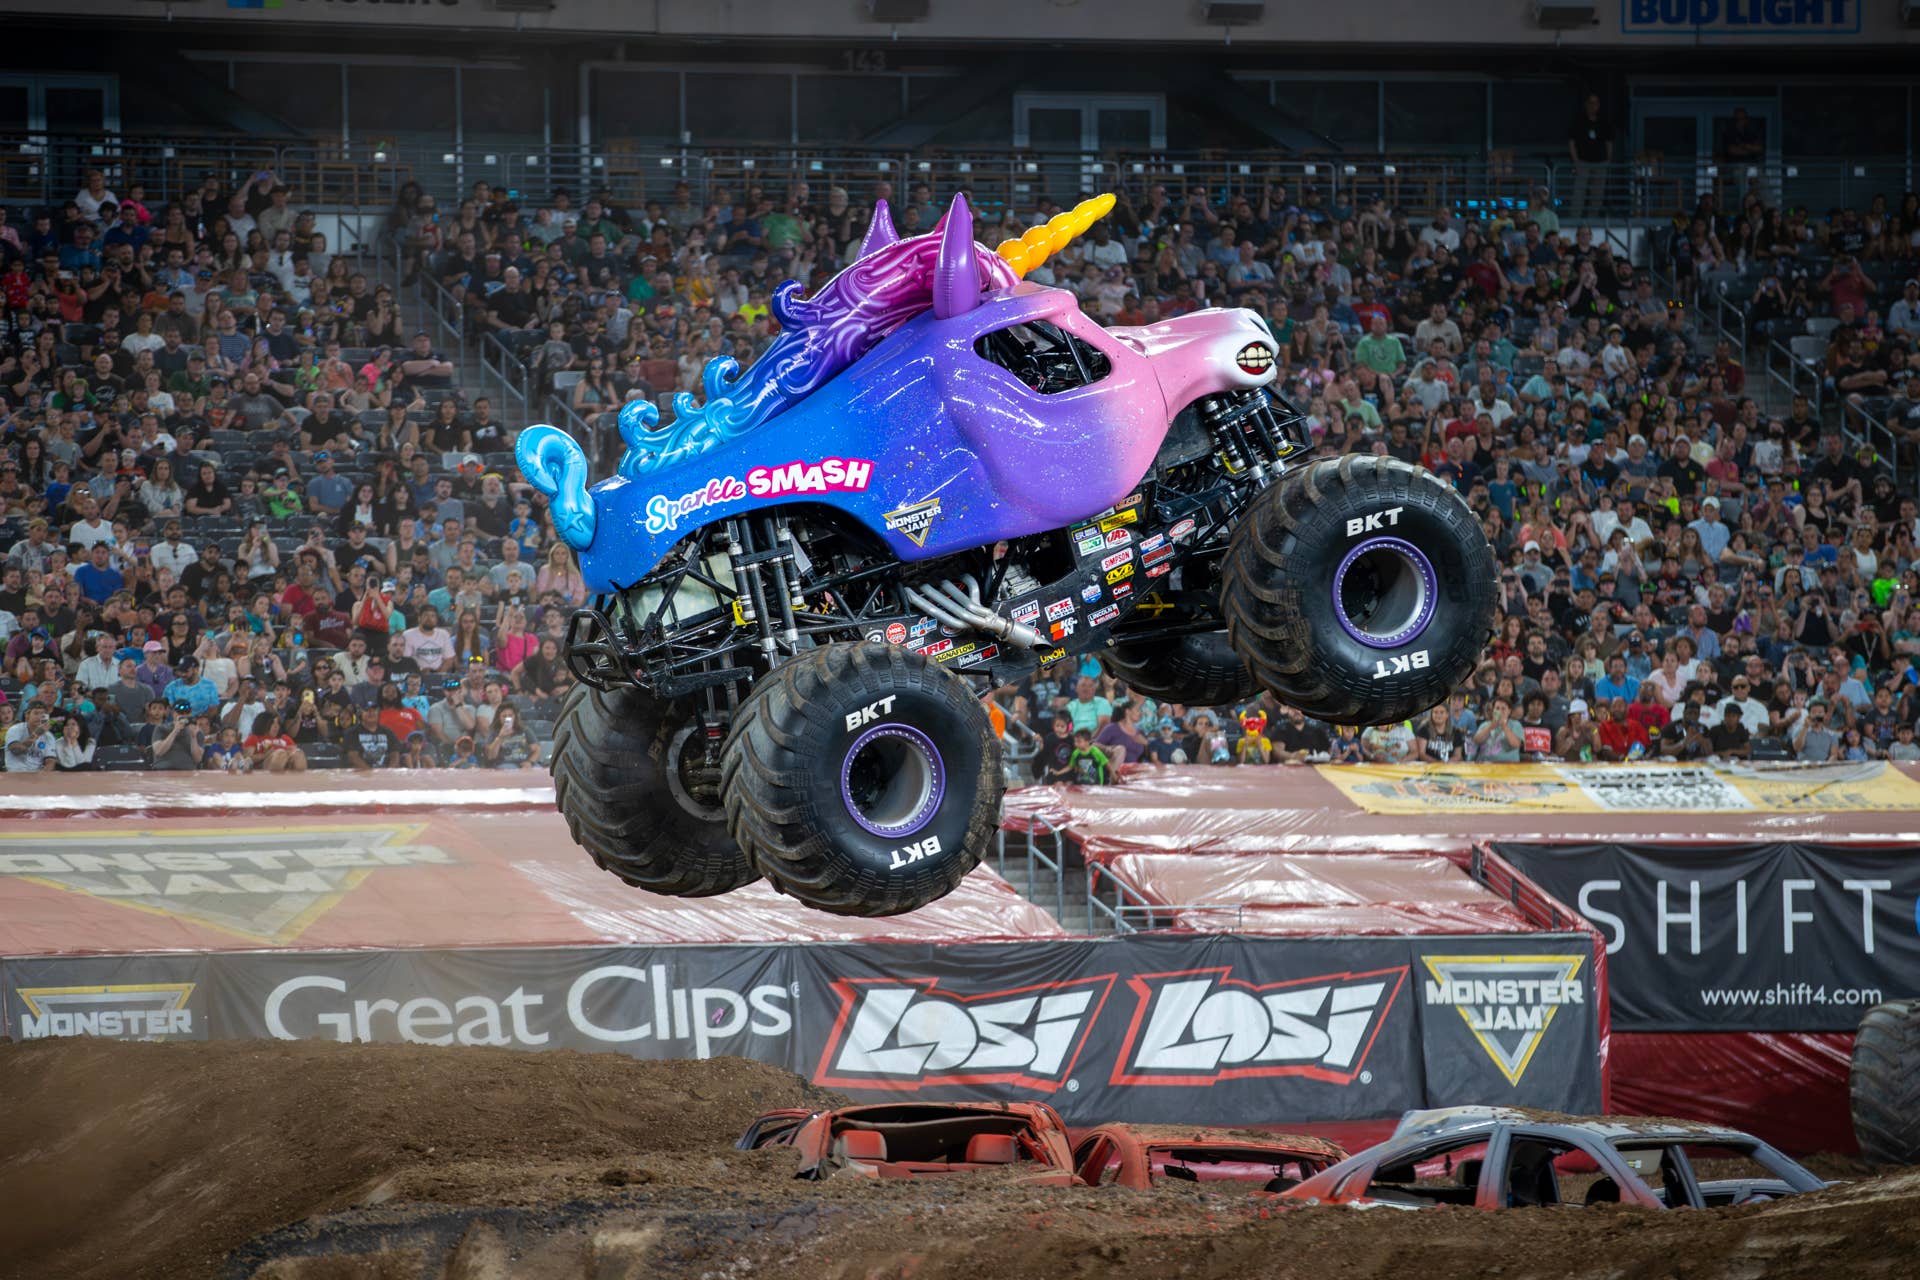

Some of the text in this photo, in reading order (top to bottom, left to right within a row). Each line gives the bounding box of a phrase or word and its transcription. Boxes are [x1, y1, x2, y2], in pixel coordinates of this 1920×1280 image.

[1631, 0, 1719, 24] BUD
[647, 458, 872, 534] Sparkle SMASH
[885, 506, 942, 531] MONSTER
[904, 519, 929, 534] JAM
[1346, 506, 1403, 537] BKT
[1080, 536, 1102, 551] BKT
[1104, 551, 1130, 569] SIMPSON
[1013, 602, 1037, 618] OPTIMA
[1089, 605, 1114, 621] LINCOLN
[936, 643, 974, 661] AGNAFLOW
[959, 652, 983, 666] Holley
[1039, 647, 1066, 664] UNOH
[1372, 650, 1430, 680] BKT
[846, 695, 897, 732] BKT
[0, 845, 457, 872] ONSTER
[889, 835, 942, 870] BKT
[92, 870, 334, 895] JAM
[1577, 879, 1892, 955] SHIFT
[1425, 979, 1584, 1005] MONSTER
[1701, 982, 1882, 1007] www.shift4.com
[21, 1009, 192, 1039] MONSTER
[264, 964, 792, 1060] Great Clips
[1472, 1004, 1545, 1031] JAM
